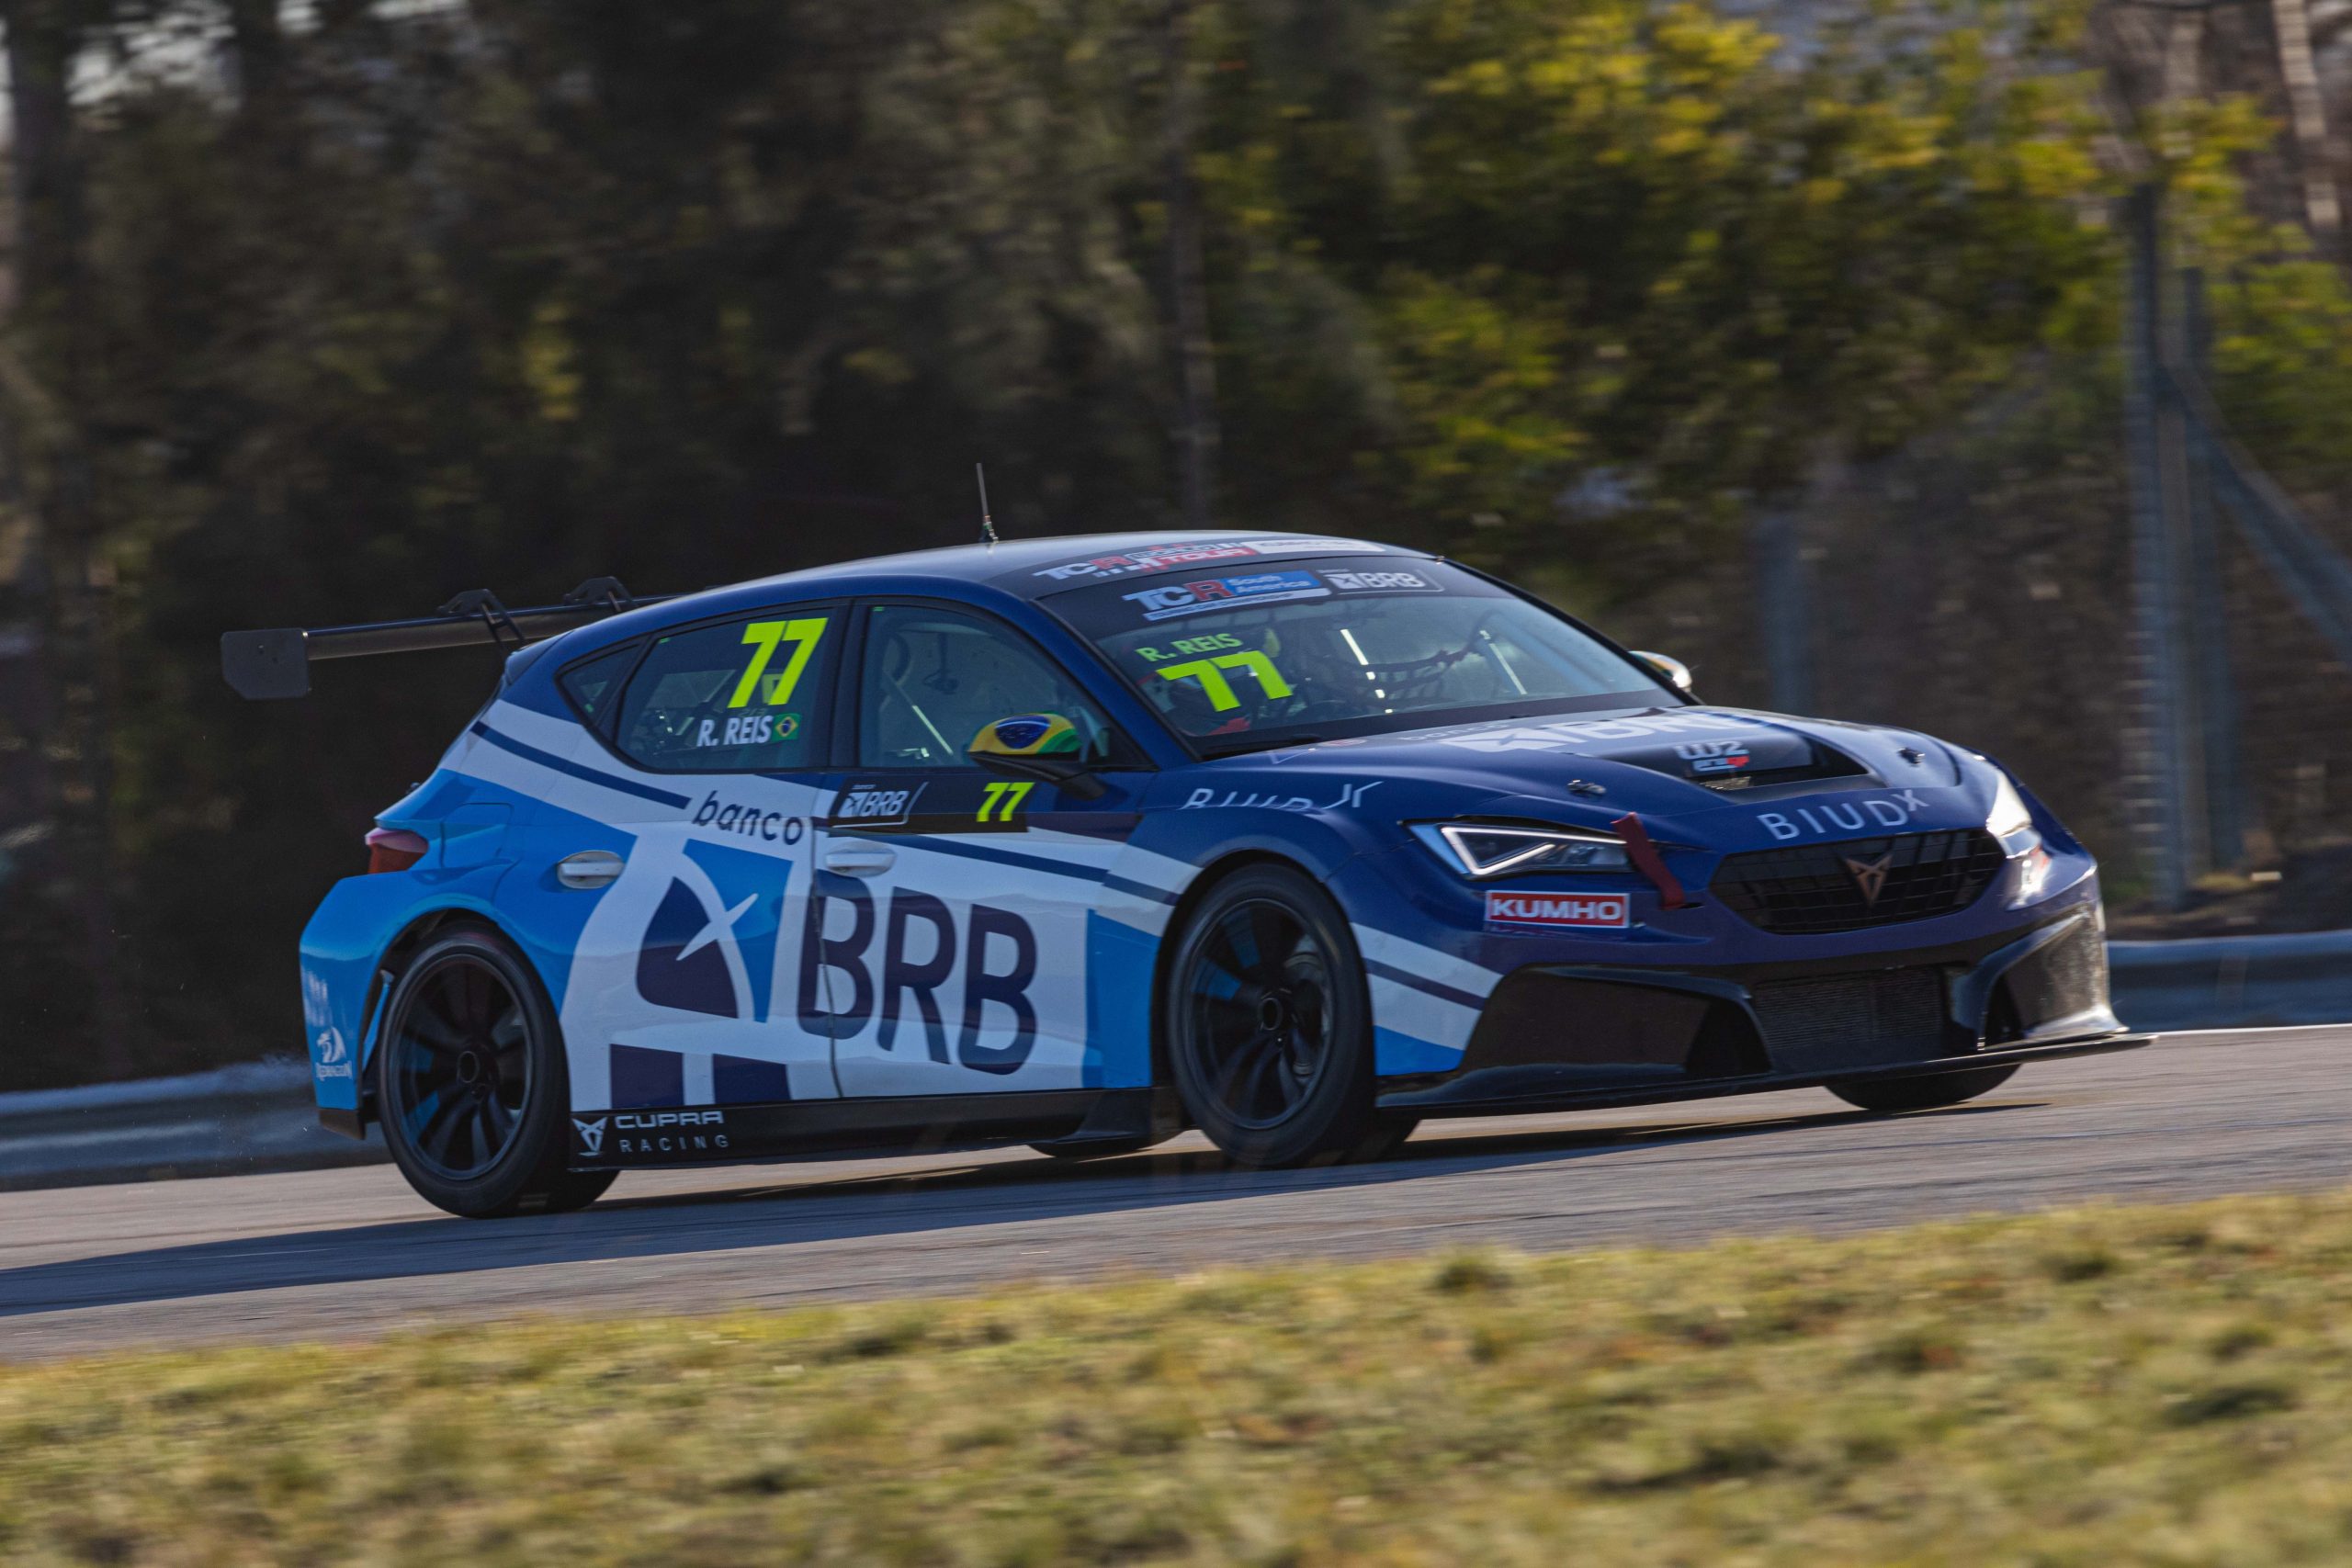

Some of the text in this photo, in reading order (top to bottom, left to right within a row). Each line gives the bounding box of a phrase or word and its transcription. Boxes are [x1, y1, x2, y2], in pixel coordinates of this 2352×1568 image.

[1033, 556, 1134, 580] TCR
[1357, 572, 1426, 588] BRB
[1121, 579, 1235, 611] TCR
[727, 617, 829, 708] 77
[1135, 633, 1243, 662] R. REIS
[1156, 649, 1294, 712] 77
[696, 715, 774, 747] R. REIS
[691, 790, 805, 845] banco
[860, 790, 910, 817] BRB
[976, 782, 1035, 822] 77
[1758, 789, 1928, 840] BIUDX
[1490, 897, 1623, 920] KUMHO
[797, 869, 1037, 1075] BRB
[615, 1111, 724, 1129] CUPRA
[619, 1134, 729, 1152] RACING
